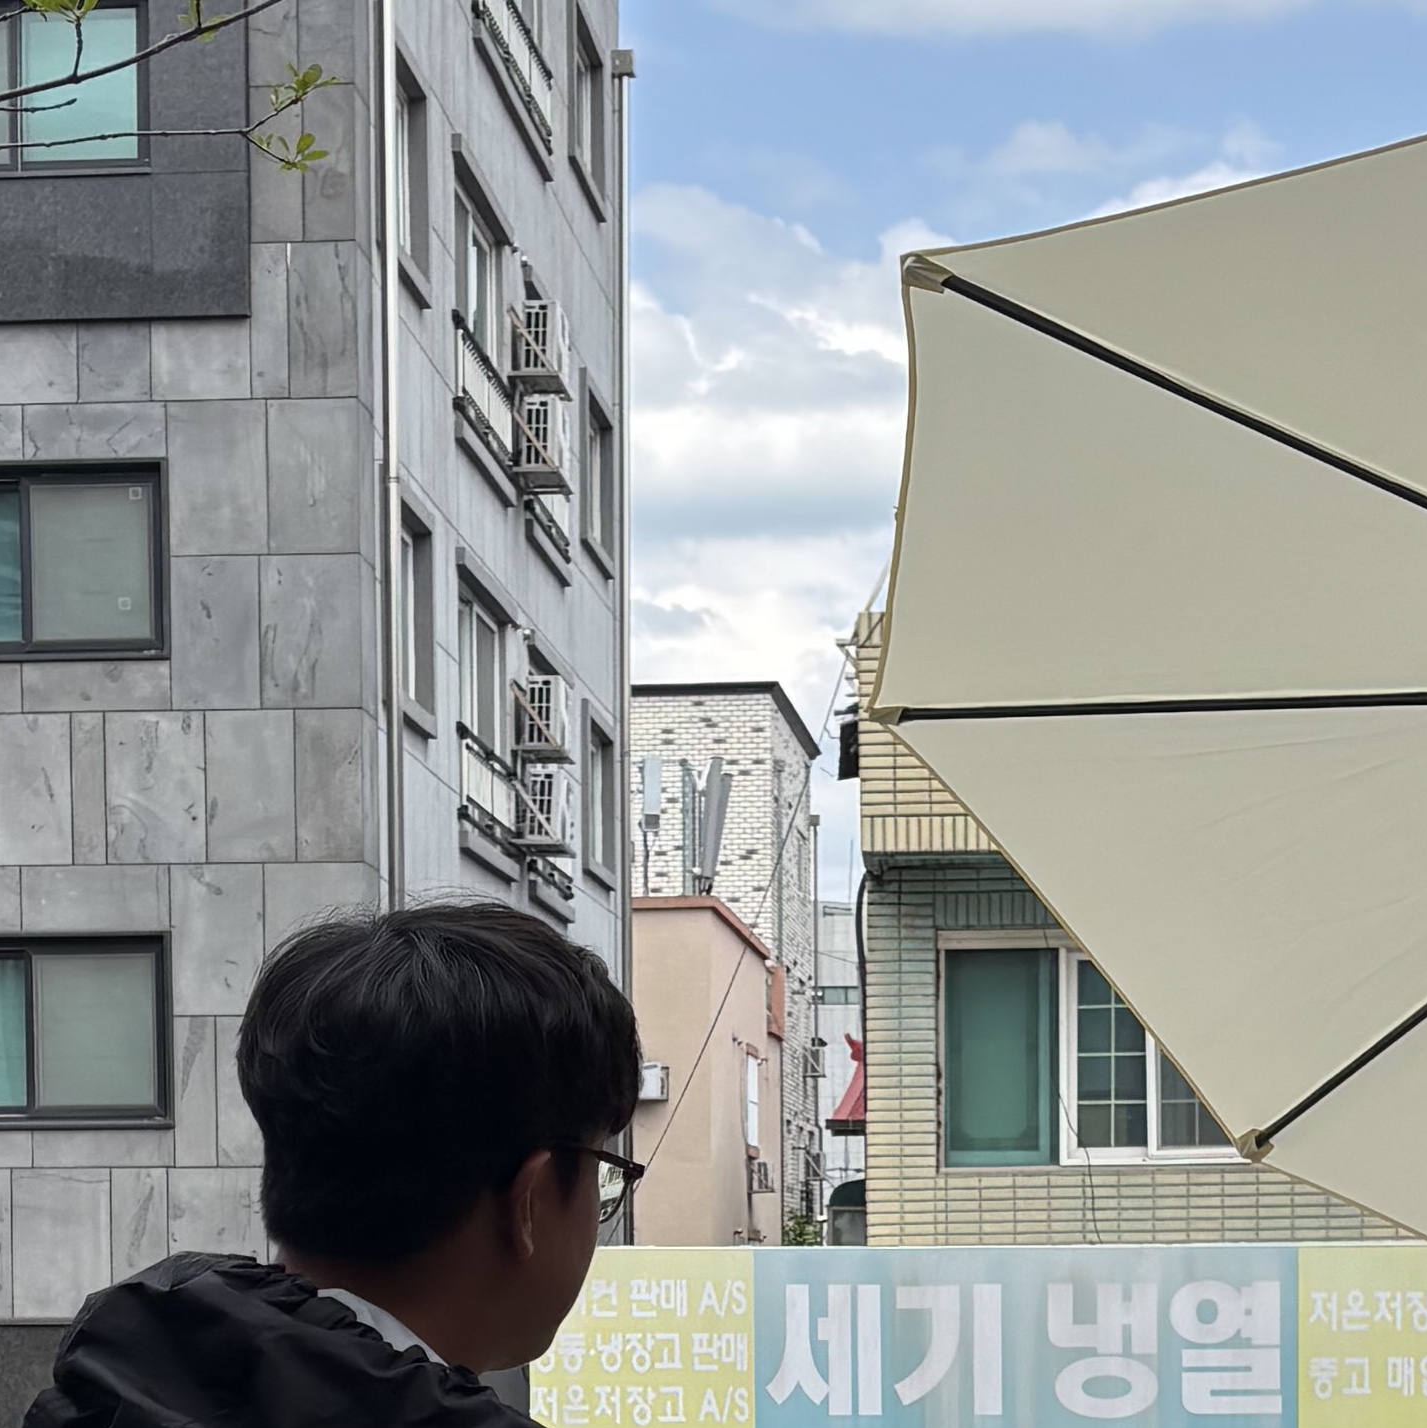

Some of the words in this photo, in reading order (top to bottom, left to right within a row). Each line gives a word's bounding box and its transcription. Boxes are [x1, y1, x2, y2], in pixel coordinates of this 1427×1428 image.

[578, 1279, 618, 1318] 컨
[630, 1278, 688, 1318] 판매
[698, 1279, 748, 1318] A/S
[691, 1331, 748, 1373] 판매
[764, 1282, 1003, 1417] 세기
[1046, 1279, 1283, 1420] 냉열
[1307, 1356, 1372, 1401] 중고
[530, 1384, 687, 1427] 저온저장고
[698, 1385, 750, 1424] A/S
